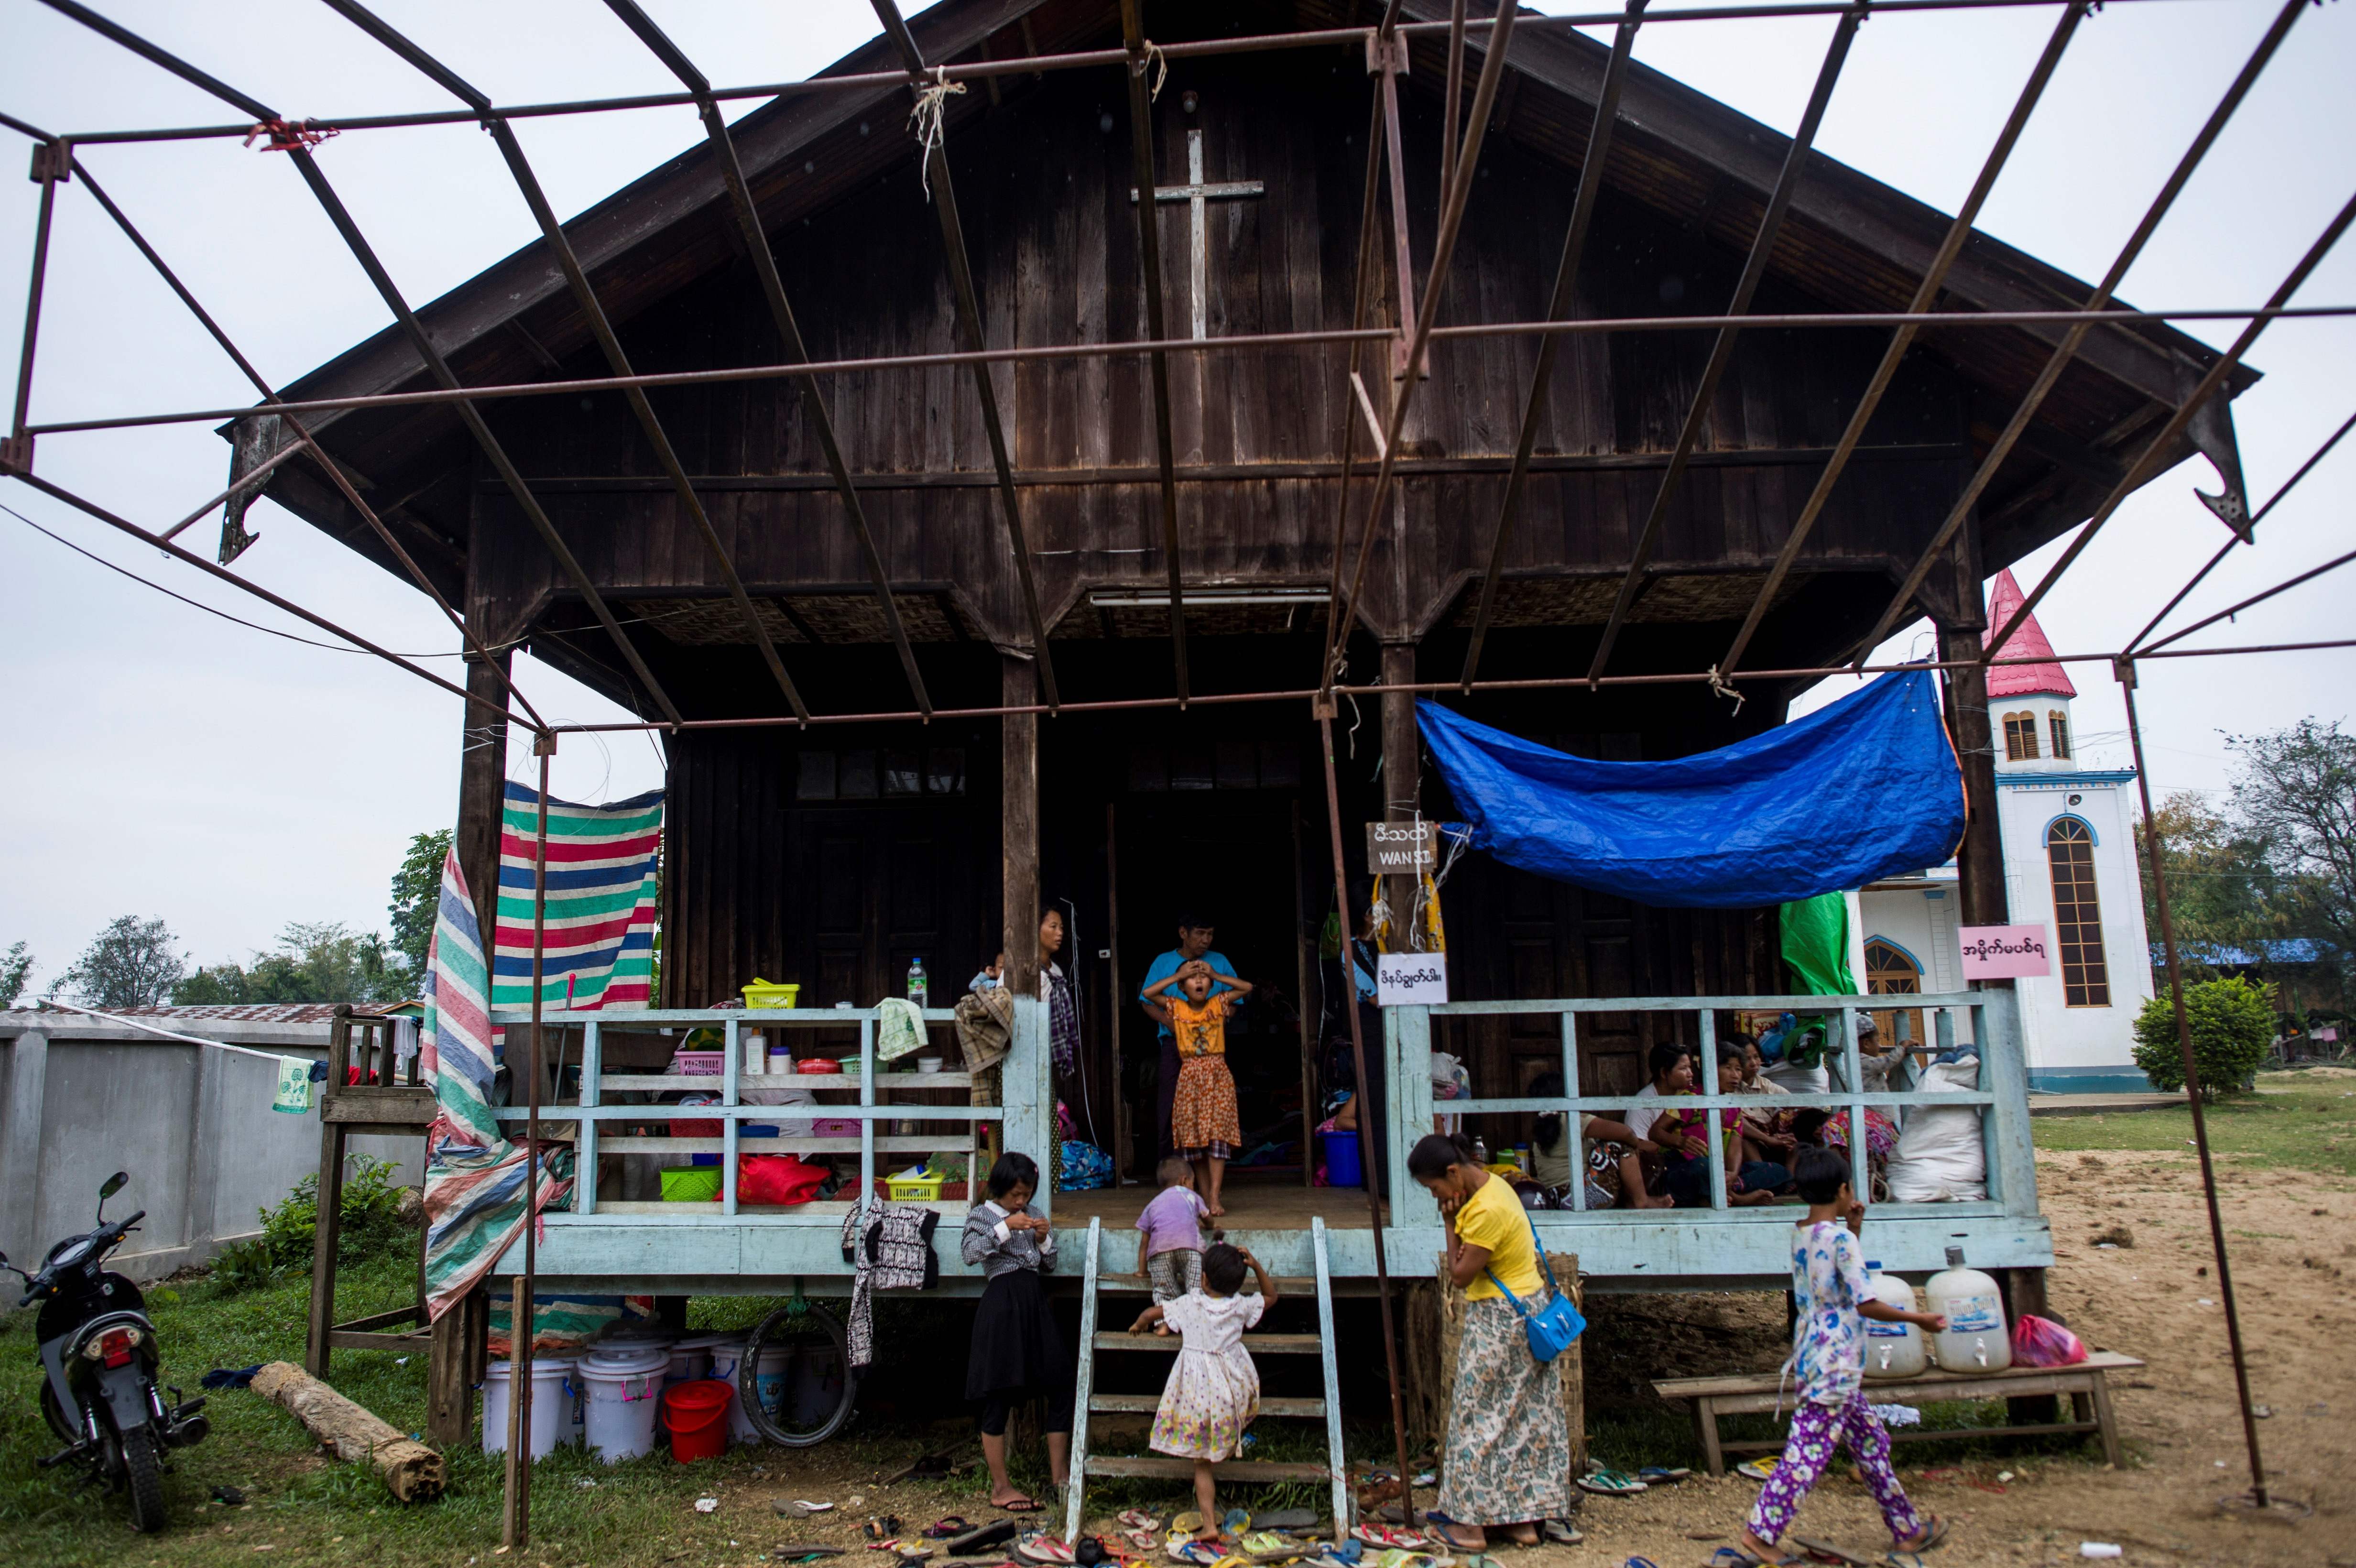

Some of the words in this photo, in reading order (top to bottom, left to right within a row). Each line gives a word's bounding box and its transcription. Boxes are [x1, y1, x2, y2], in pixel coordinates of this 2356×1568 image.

[1963, 937, 2046, 961] အမှိုက်မပစ်ရ
